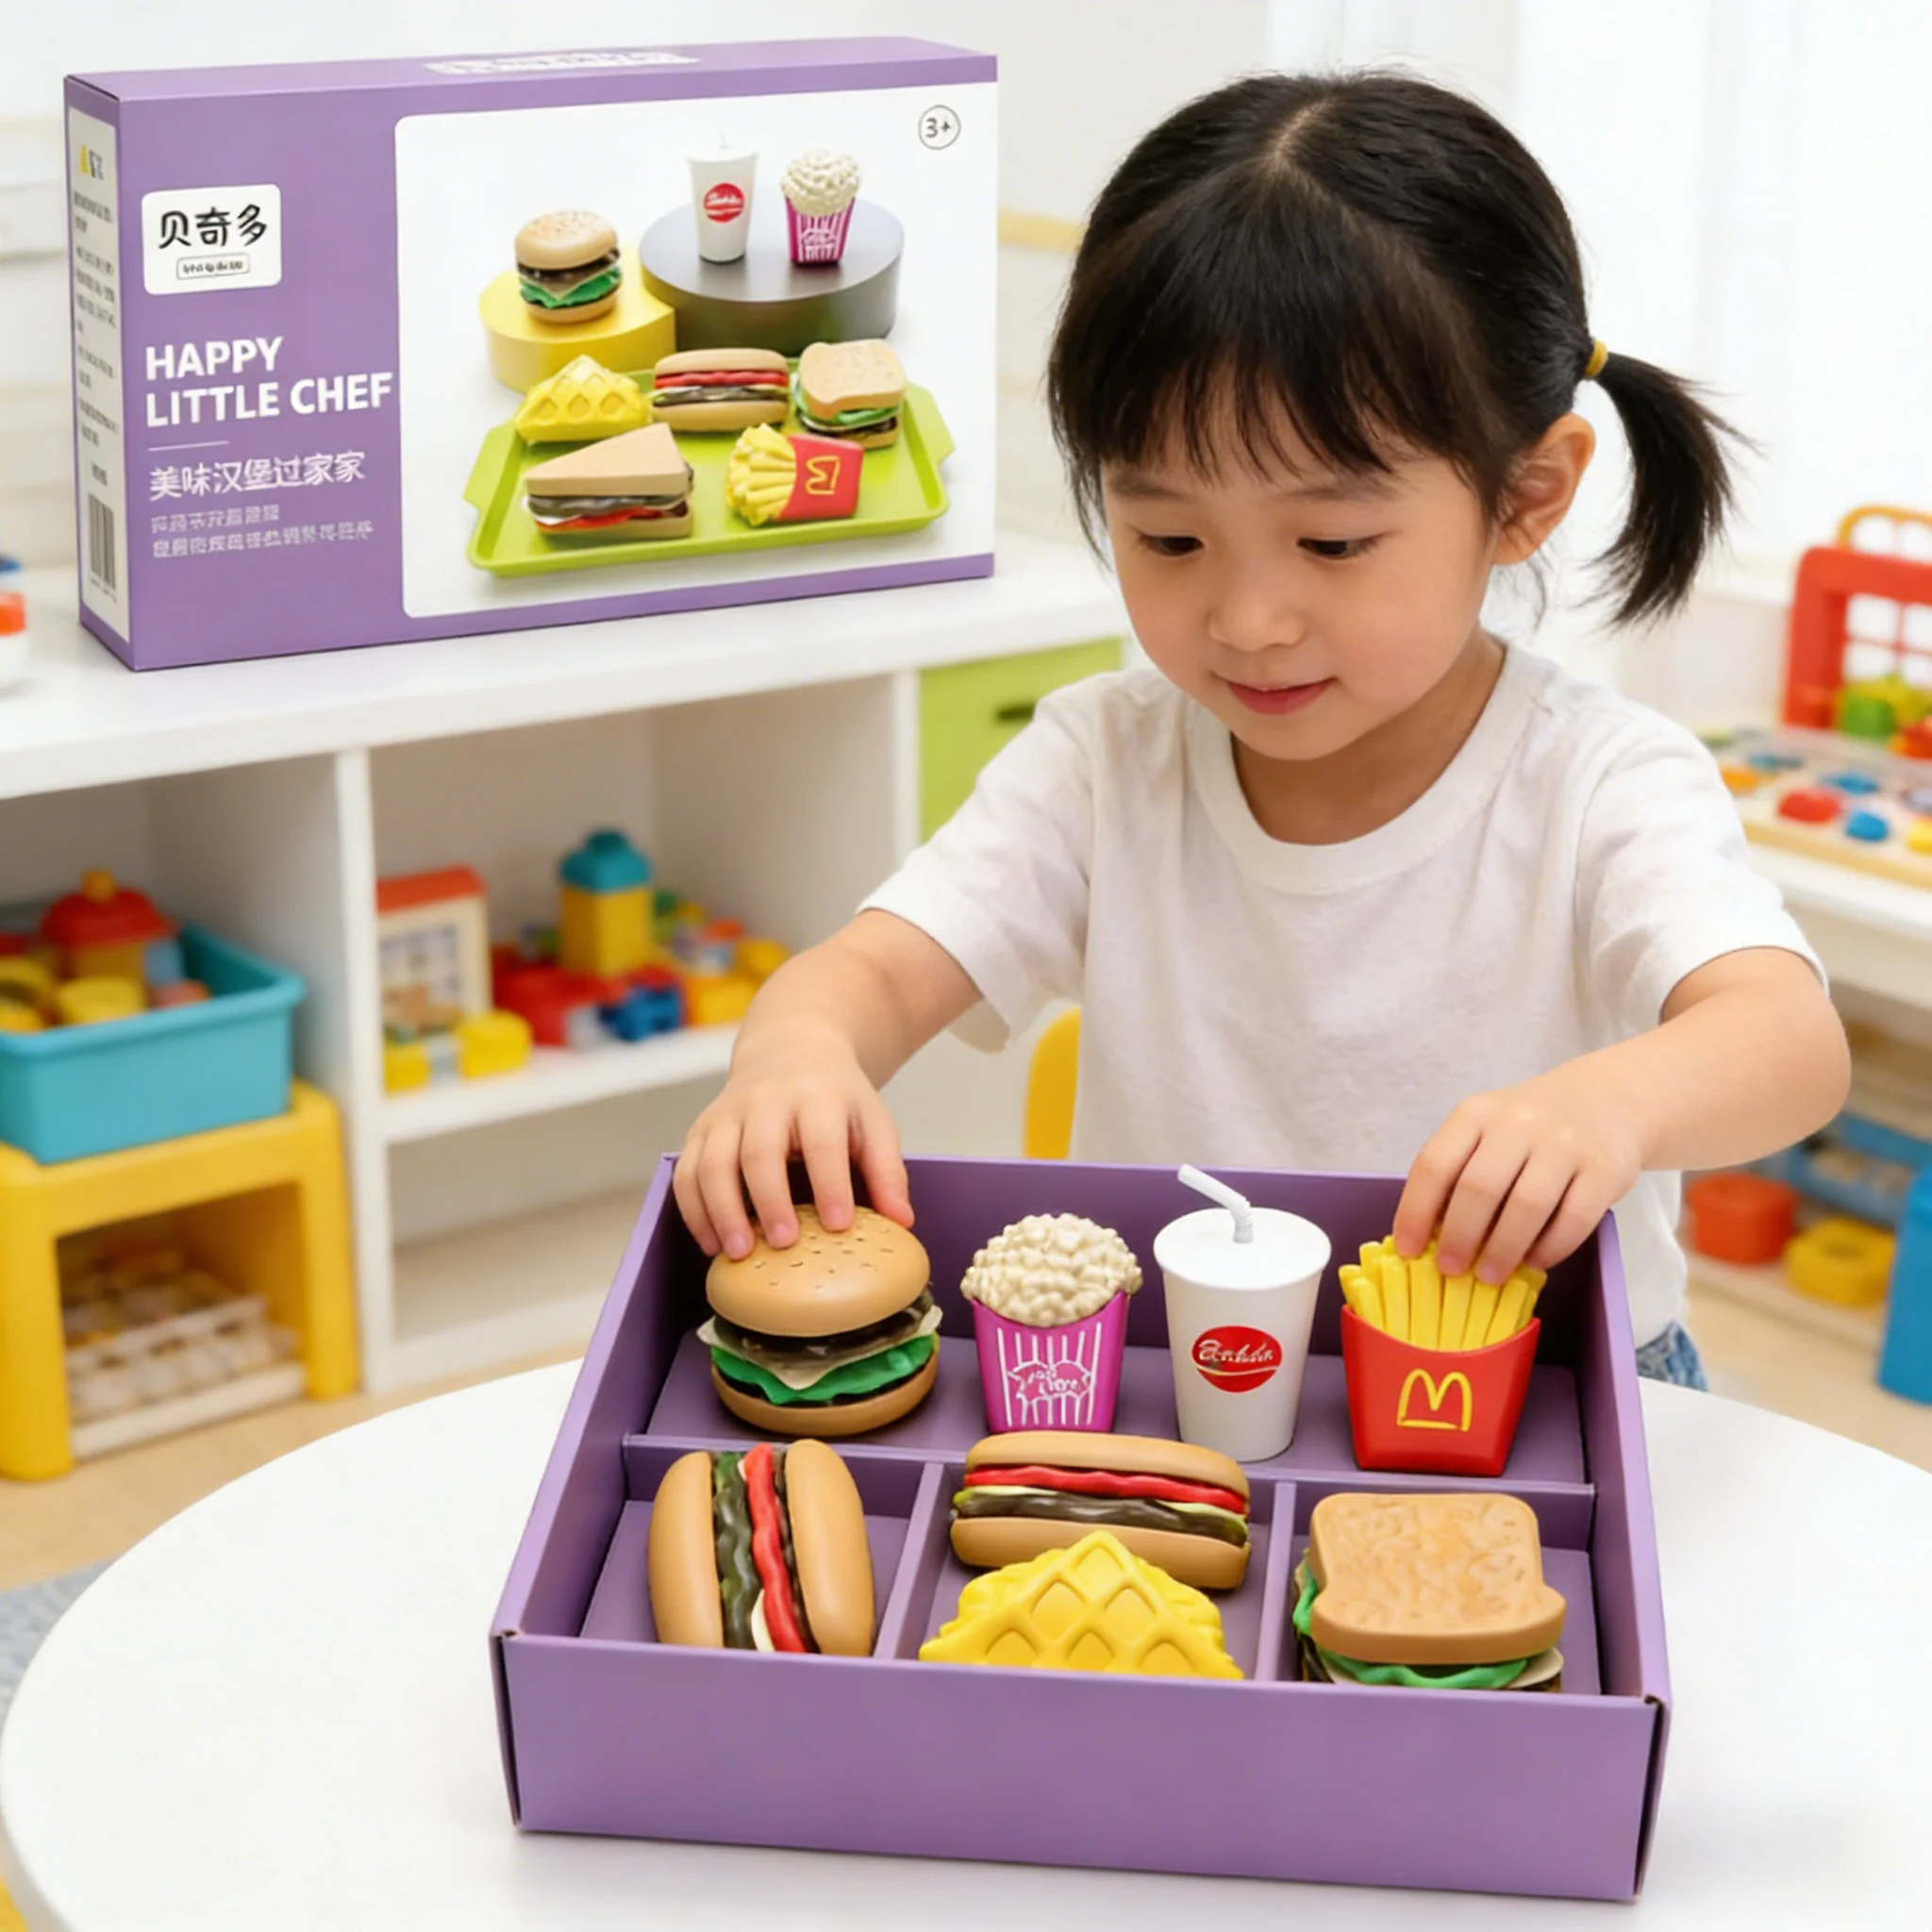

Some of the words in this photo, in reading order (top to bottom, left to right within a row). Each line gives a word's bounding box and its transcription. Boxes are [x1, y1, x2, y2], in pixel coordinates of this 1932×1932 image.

[925, 117, 952, 139] 3+
[158, 203, 267, 249] 贝奇多
[145, 336, 284, 381] HAPPY
[146, 381, 280, 428] LITTLE
[290, 372, 393, 415] CHEF
[149, 449, 366, 502] 美味汉堡过家家
